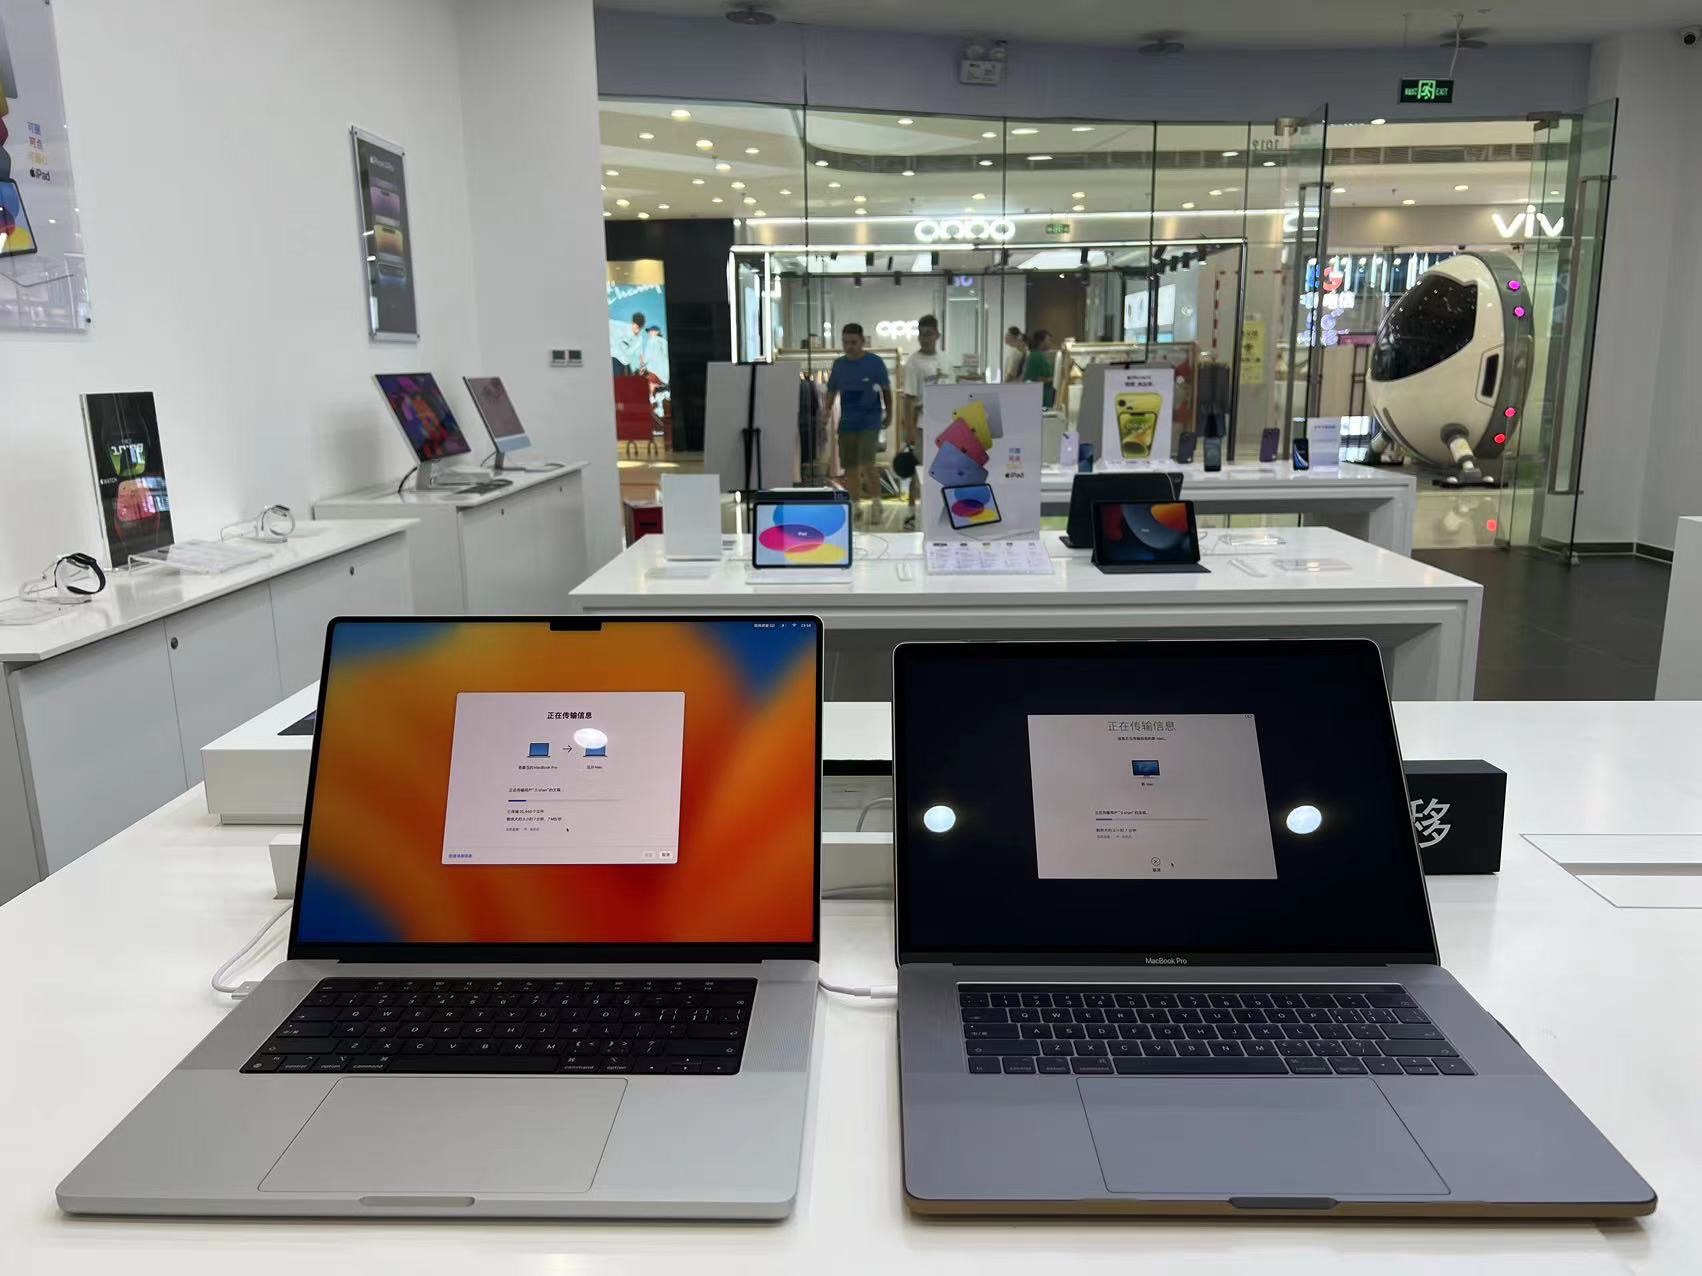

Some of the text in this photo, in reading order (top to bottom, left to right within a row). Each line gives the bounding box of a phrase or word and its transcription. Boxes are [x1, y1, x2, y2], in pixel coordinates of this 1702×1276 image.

[547, 711, 593, 720] 正在传输信息
[1107, 720, 1177, 732] 正在传输信息
[1410, 798, 1451, 848] 移
